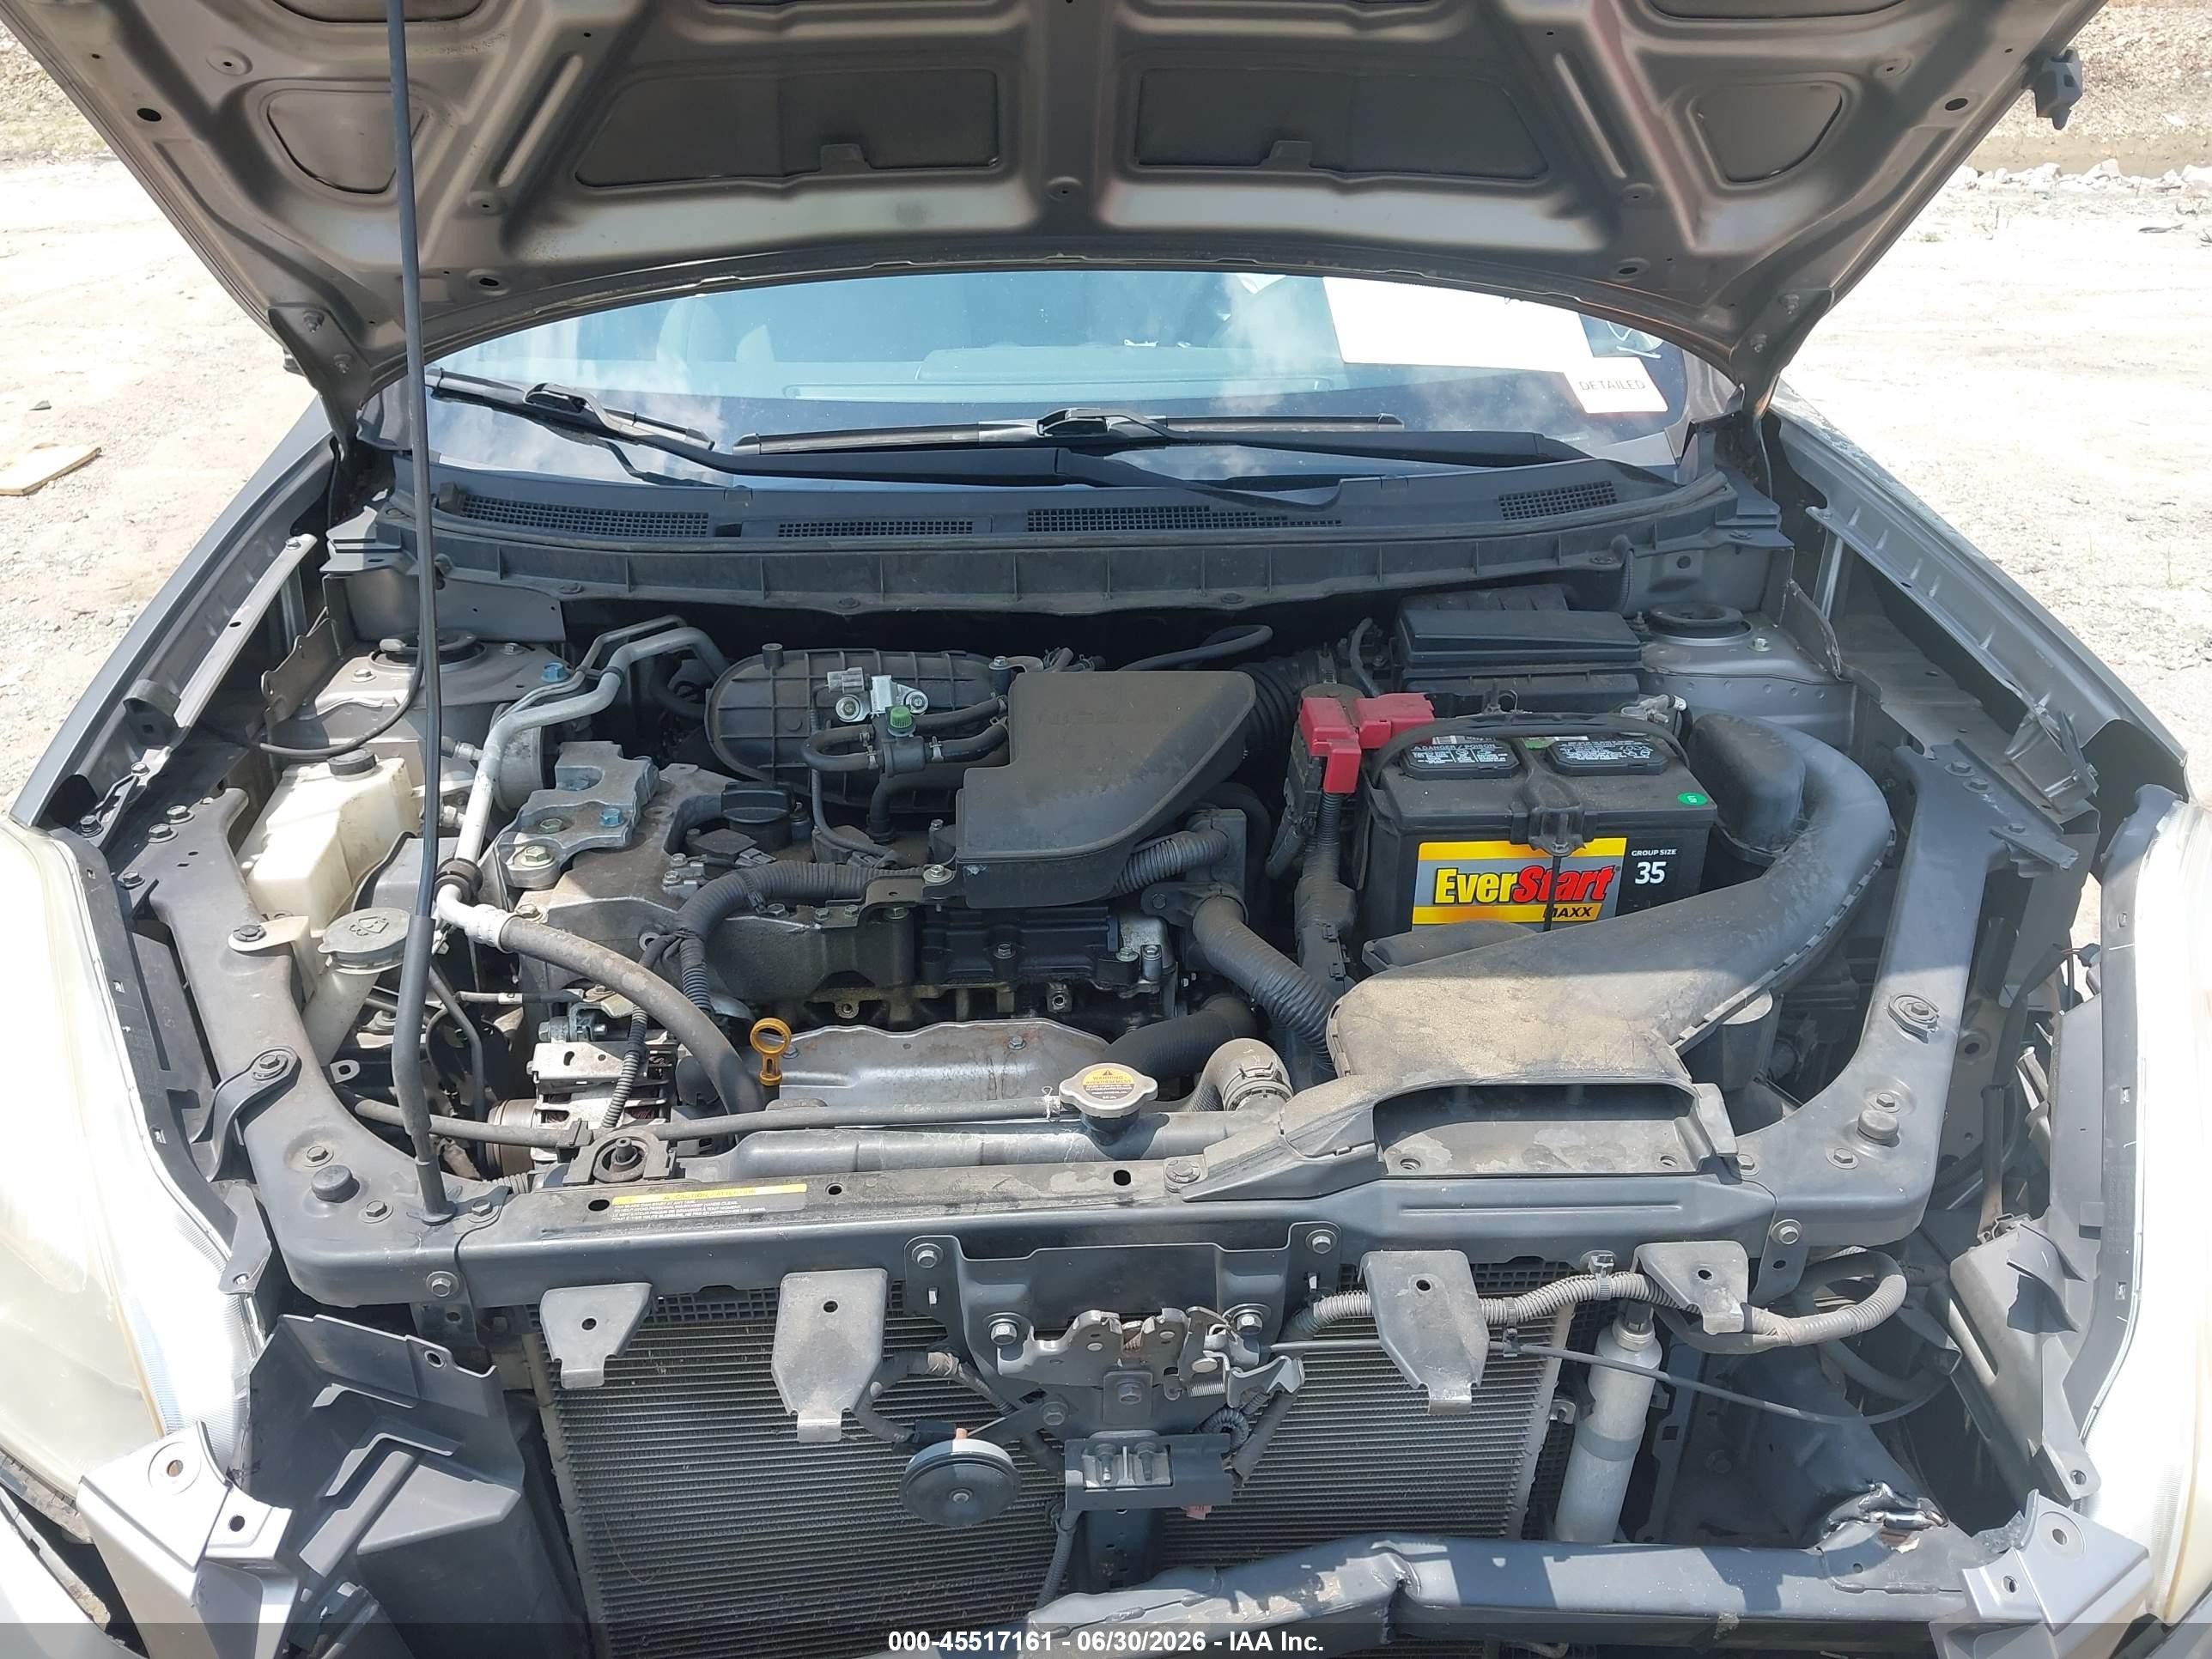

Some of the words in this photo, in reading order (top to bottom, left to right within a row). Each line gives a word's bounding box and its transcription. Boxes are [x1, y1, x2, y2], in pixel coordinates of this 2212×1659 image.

[1579, 380, 1645, 391] DETAILED
[1634, 861, 1667, 884] 35
[1433, 865, 1615, 904] EverStart
